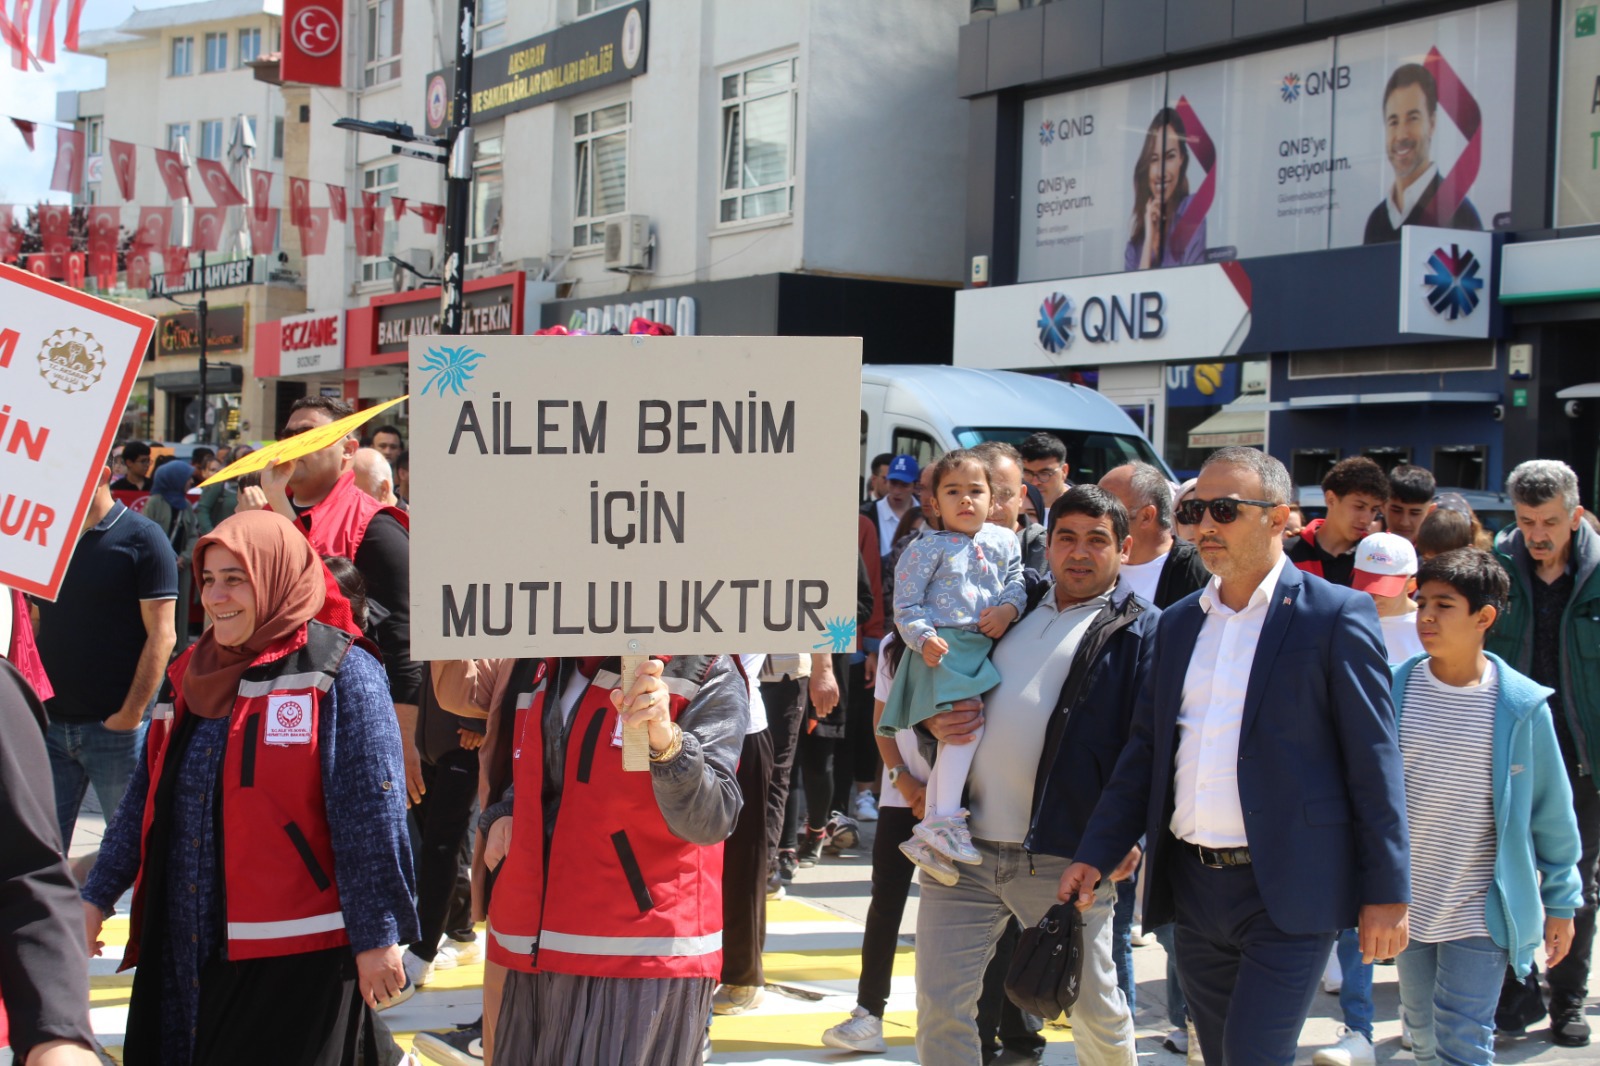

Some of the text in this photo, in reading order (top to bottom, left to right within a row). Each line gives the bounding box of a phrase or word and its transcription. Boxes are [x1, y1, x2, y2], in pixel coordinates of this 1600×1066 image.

[508, 43, 546, 75] AKSARAY
[541, 60, 578, 92] ODALARI
[579, 43, 613, 80] BİRLİĞİ
[1304, 65, 1351, 96] QNB
[1057, 115, 1095, 141] QNB
[1279, 136, 1326, 158] QNB'ye
[1037, 175, 1077, 195] QNB'ye
[1278, 157, 1351, 185] geçiyorum.
[1036, 195, 1093, 218] geçiyorum.
[1081, 291, 1165, 343] QNB
[281, 315, 338, 352] ECZANE
[448, 391, 608, 456] AİLEM
[637, 390, 796, 454] BENİM
[589, 480, 686, 550] İÇİN
[442, 578, 829, 638] MUTLULUKTUR
